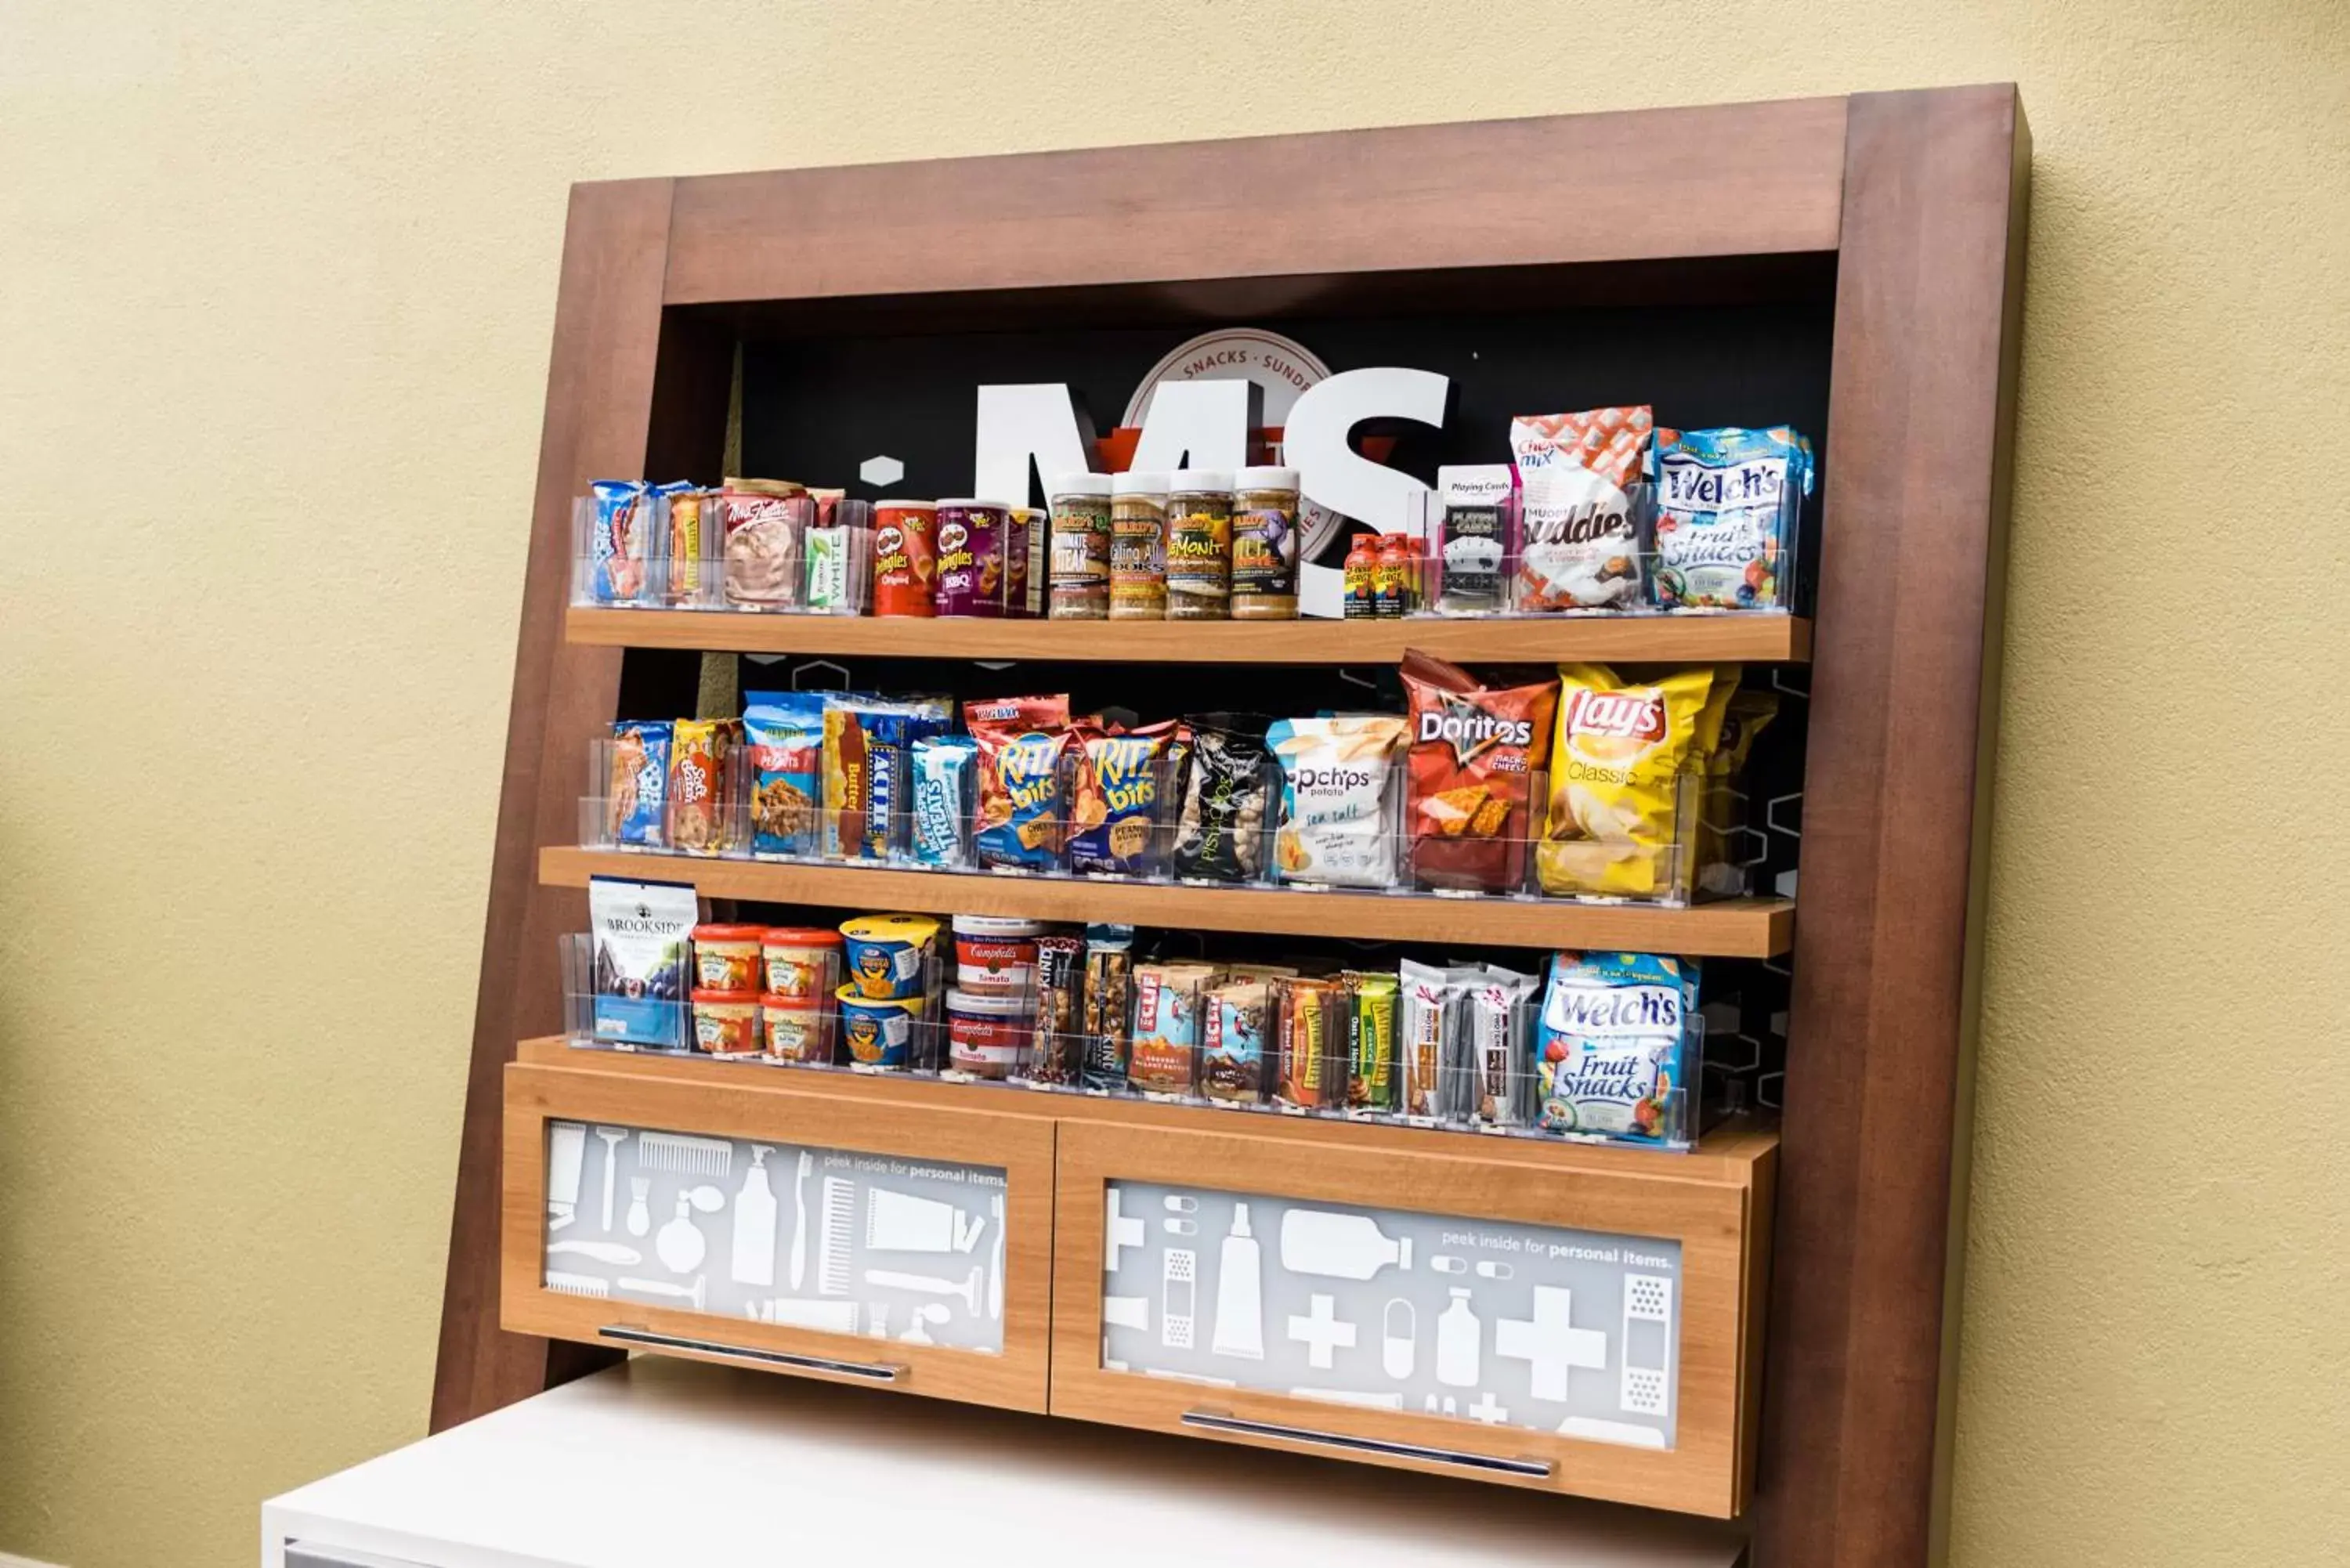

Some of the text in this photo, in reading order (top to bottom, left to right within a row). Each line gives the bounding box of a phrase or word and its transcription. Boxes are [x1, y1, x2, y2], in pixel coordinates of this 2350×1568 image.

[1183, 350, 1314, 392] SNACKS SUNDR
[1452, 481, 1509, 493] Playing Cards
[1667, 465, 1780, 504] Welch's
[830, 534, 841, 600] WHITE
[1419, 712, 1533, 744] Doritos
[1570, 688, 1664, 736] Lay's
[997, 742, 1055, 787] RITZ
[1095, 738, 1155, 788] RITZ
[1568, 760, 1638, 786] Classic
[848, 763, 862, 811] Butter
[1106, 780, 1156, 814] bits
[1311, 787, 1343, 797] potato
[926, 779, 960, 853] TREATS
[1561, 990, 1677, 1027] Welch's
[1102, 1033, 1115, 1072] KIND
[1578, 1054, 1639, 1078] Fruit
[1558, 1072, 1647, 1099] Snacks
[825, 1155, 1008, 1187] peek inside for personal items.
[1442, 1230, 1674, 1269] peek inside for personal items.
